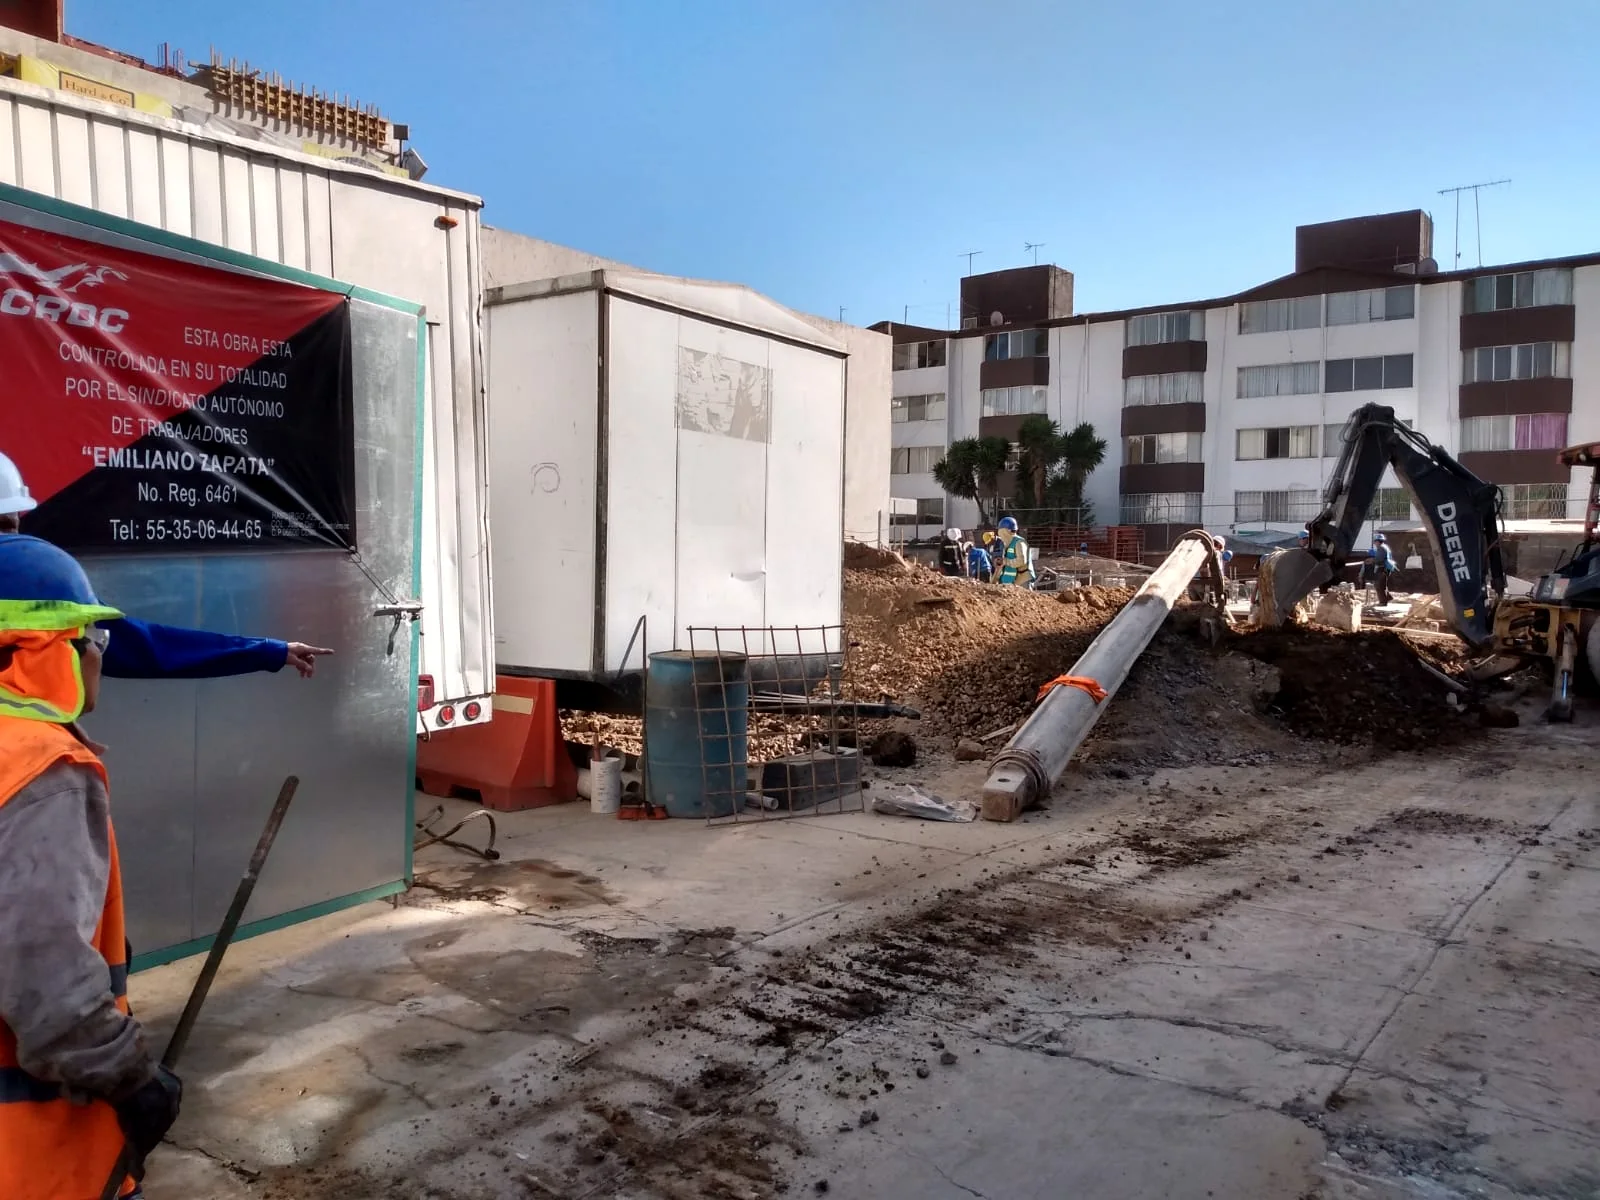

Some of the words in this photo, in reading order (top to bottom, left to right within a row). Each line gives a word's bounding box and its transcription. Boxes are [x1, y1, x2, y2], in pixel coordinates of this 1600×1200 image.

[184, 327, 219, 348] ESTA
[223, 333, 258, 353] OBRA
[262, 339, 292, 358] ESTA
[59, 342, 167, 374] CONTROLADA
[171, 360, 190, 378] EN
[195, 363, 214, 381] SU
[218, 365, 287, 389] TOTALIDAD
[65, 377, 101, 399] POR
[107, 382, 126, 401] EL
[128, 386, 207, 411] SINDICATO
[210, 395, 284, 418] AUTÓNOMO
[111, 416, 133, 435] DE
[138, 418, 248, 445] TRABAJADORES
[138, 482, 163, 502] No.
[168, 483, 200, 507] Reg.
[205, 485, 237, 503] 6461
[110, 519, 140, 540] Tel:
[146, 519, 262, 540] 55-35-06-44-65
[1437, 501, 1471, 583] DEERE
